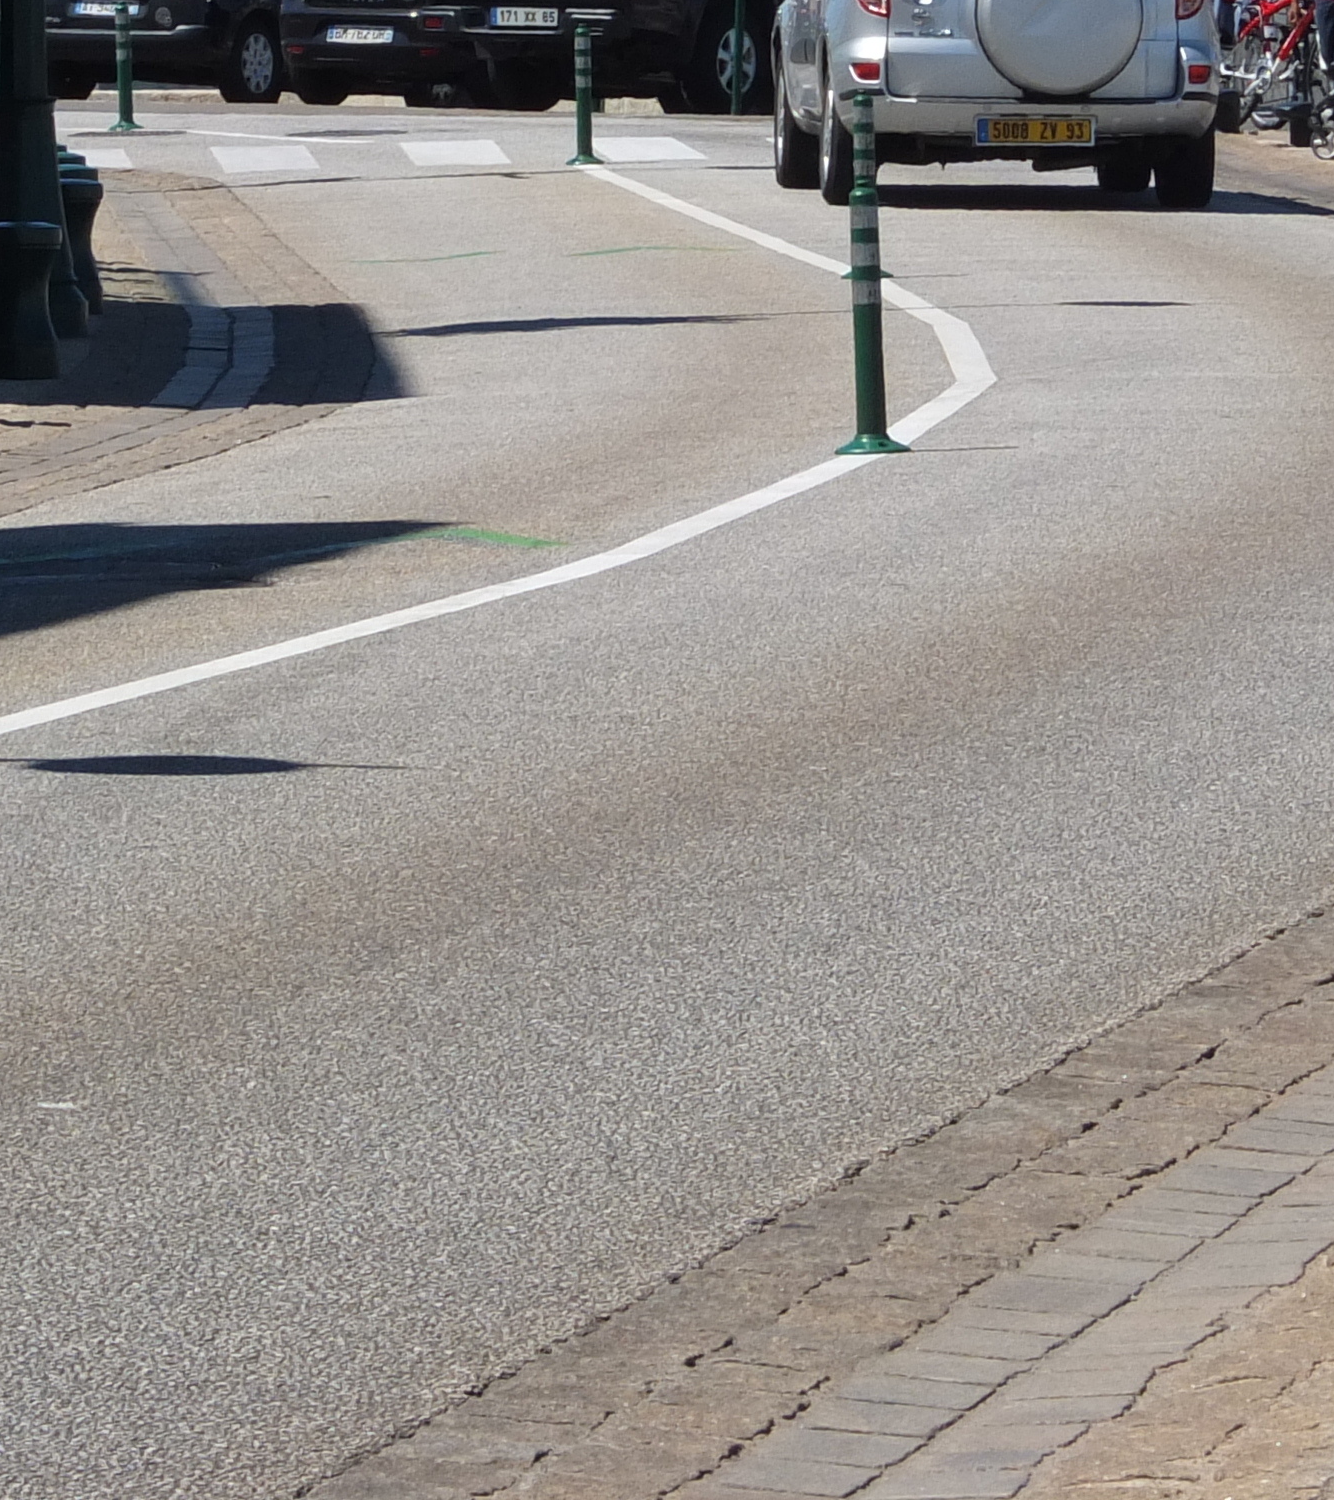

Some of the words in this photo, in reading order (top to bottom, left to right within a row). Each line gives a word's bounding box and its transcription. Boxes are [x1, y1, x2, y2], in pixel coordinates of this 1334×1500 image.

[499, 8, 518, 23] 171
[524, 8, 537, 23] XX
[993, 121, 1029, 139] 5008
[1040, 121, 1058, 140] ZV
[1066, 122, 1084, 139] 93
